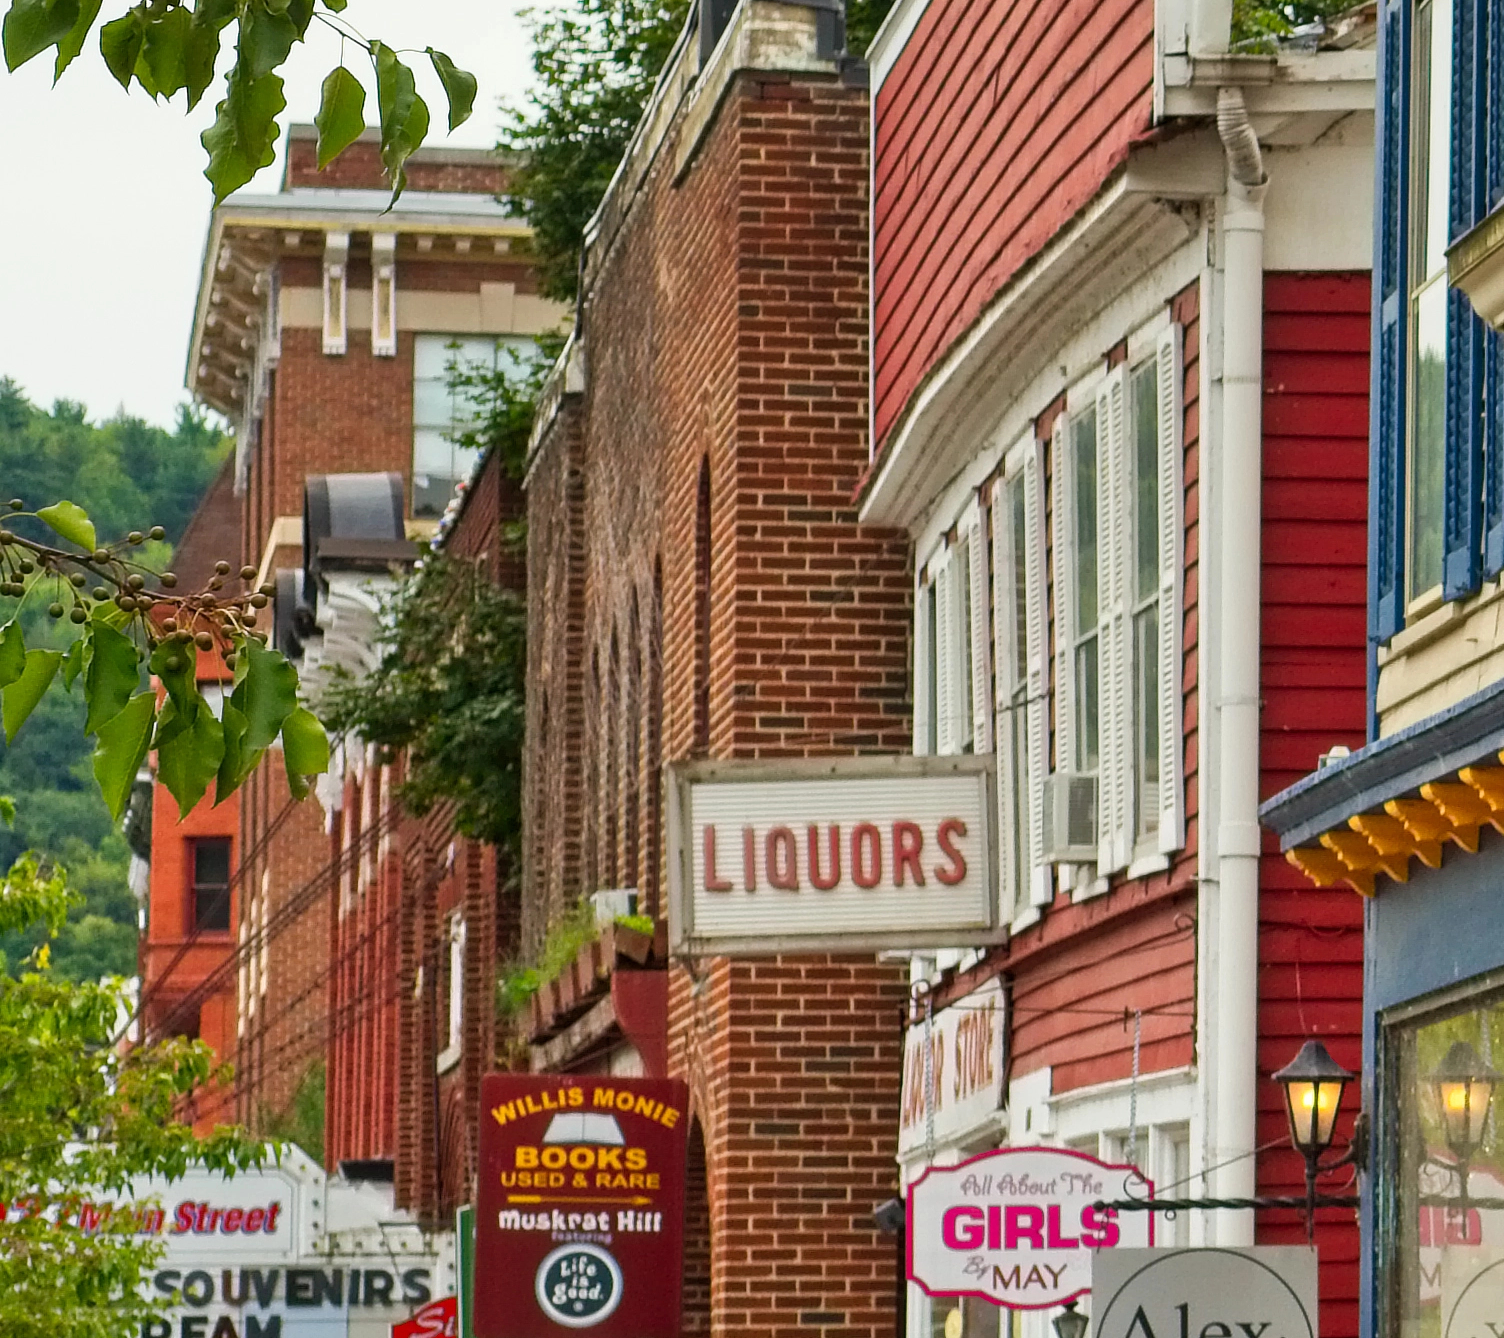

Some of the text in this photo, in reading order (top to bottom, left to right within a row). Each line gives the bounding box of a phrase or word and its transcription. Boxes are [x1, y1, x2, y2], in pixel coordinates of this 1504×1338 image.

[703, 817, 968, 892] LIQUORS
[491, 1087, 680, 1129] WILLIS MONIE
[515, 1146, 648, 1171] BOOKS
[501, 1172, 661, 1190] USED & RARE
[961, 1172, 1103, 1197] All About The
[173, 1201, 280, 1236] Street
[498, 1209, 663, 1232] Muskrat Hill
[941, 1204, 1120, 1251] GIRLS
[560, 1256, 598, 1278] Life
[572, 1274, 589, 1287] is
[961, 1257, 1068, 1290] By MAY
[153, 1268, 432, 1310] SOUVENIRS
